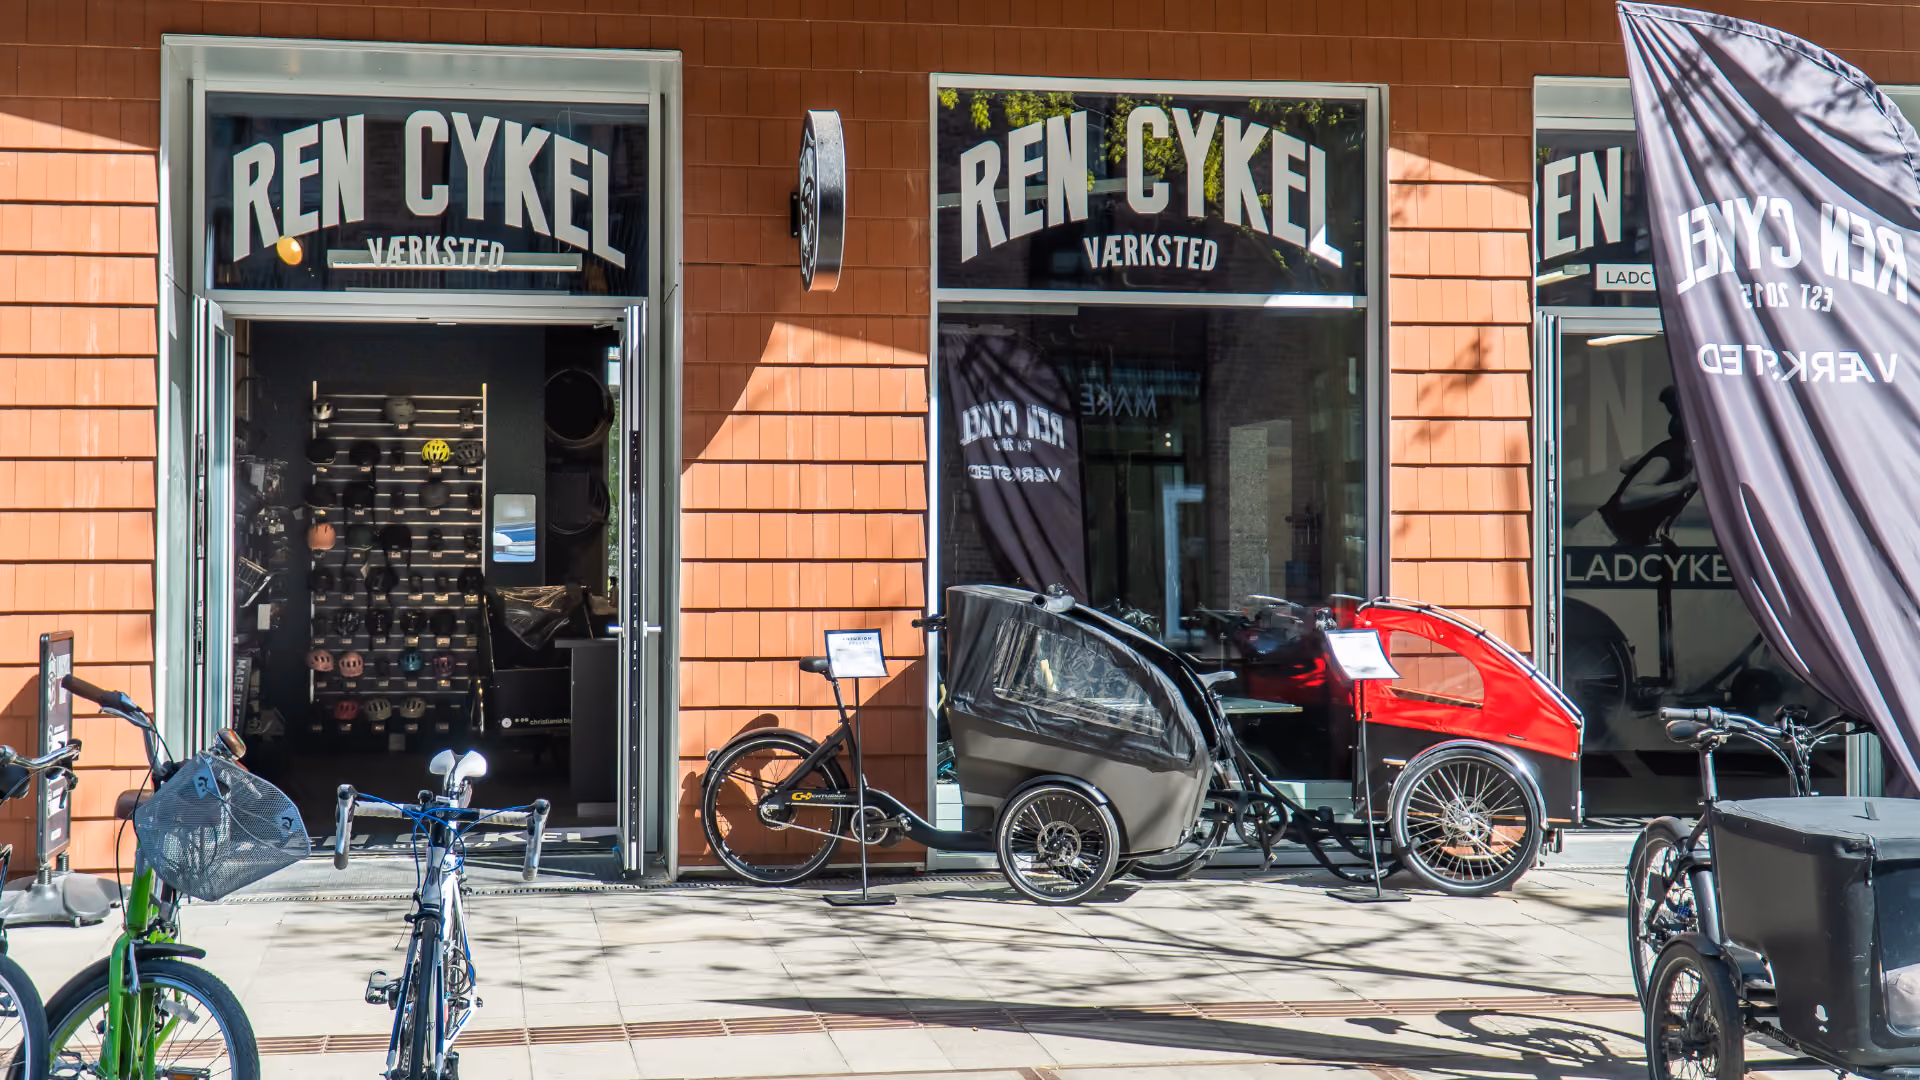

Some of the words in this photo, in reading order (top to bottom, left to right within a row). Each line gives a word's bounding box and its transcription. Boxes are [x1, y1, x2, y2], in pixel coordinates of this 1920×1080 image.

[233, 113, 365, 263] REN
[405, 110, 626, 270] CYKEL
[960, 110, 1089, 264] REN
[1126, 106, 1343, 269] CYKEL
[1536, 147, 1622, 263] EN
[367, 236, 505, 272] VÆRKSTED
[1083, 234, 1219, 272] VÆRKSTED
[1606, 271, 1654, 284] LADC
